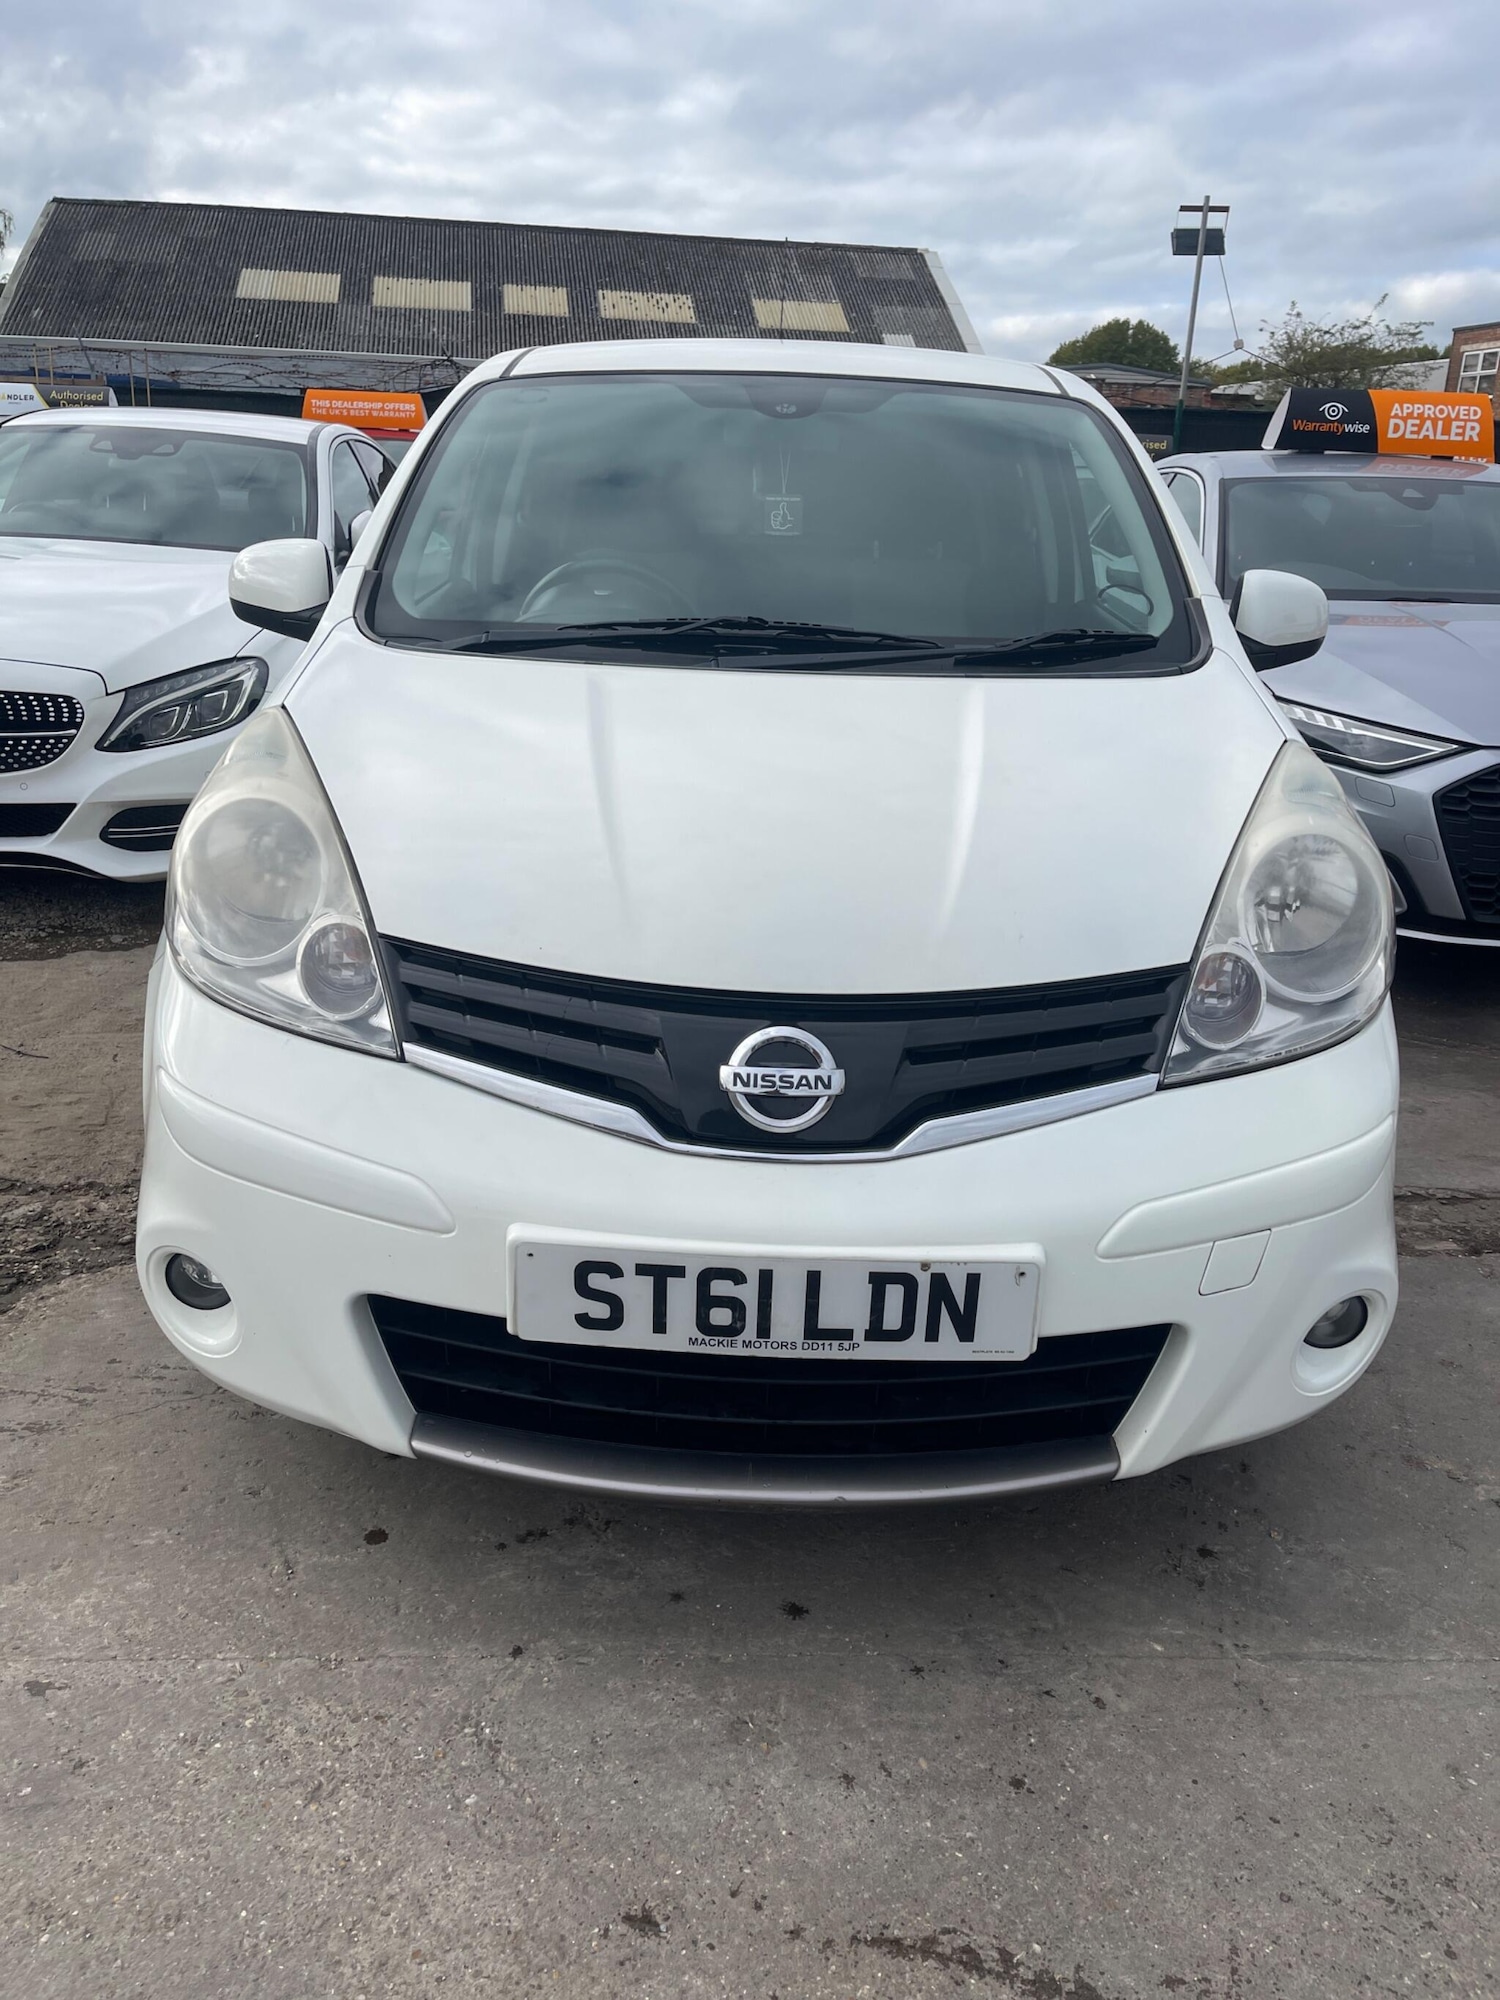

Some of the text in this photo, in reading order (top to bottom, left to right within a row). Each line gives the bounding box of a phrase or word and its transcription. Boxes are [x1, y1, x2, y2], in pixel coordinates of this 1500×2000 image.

[50, 390, 104, 401] Authorised
[311, 399, 416, 411] THIS DEALERSHIP OFFERS
[329, 408, 348, 416] UK'S
[350, 409, 370, 417] BEST
[371, 410, 416, 418] WARRANTY
[1390, 403, 1482, 420] APPROVED
[1292, 419, 1371, 435] Warrantywise
[1387, 418, 1481, 442] DEALER
[732, 1072, 832, 1090] NISSAN
[802, 1269, 981, 1343] LDN
[688, 1337, 860, 1352] MACKIE MOTORS DD11 5JP
